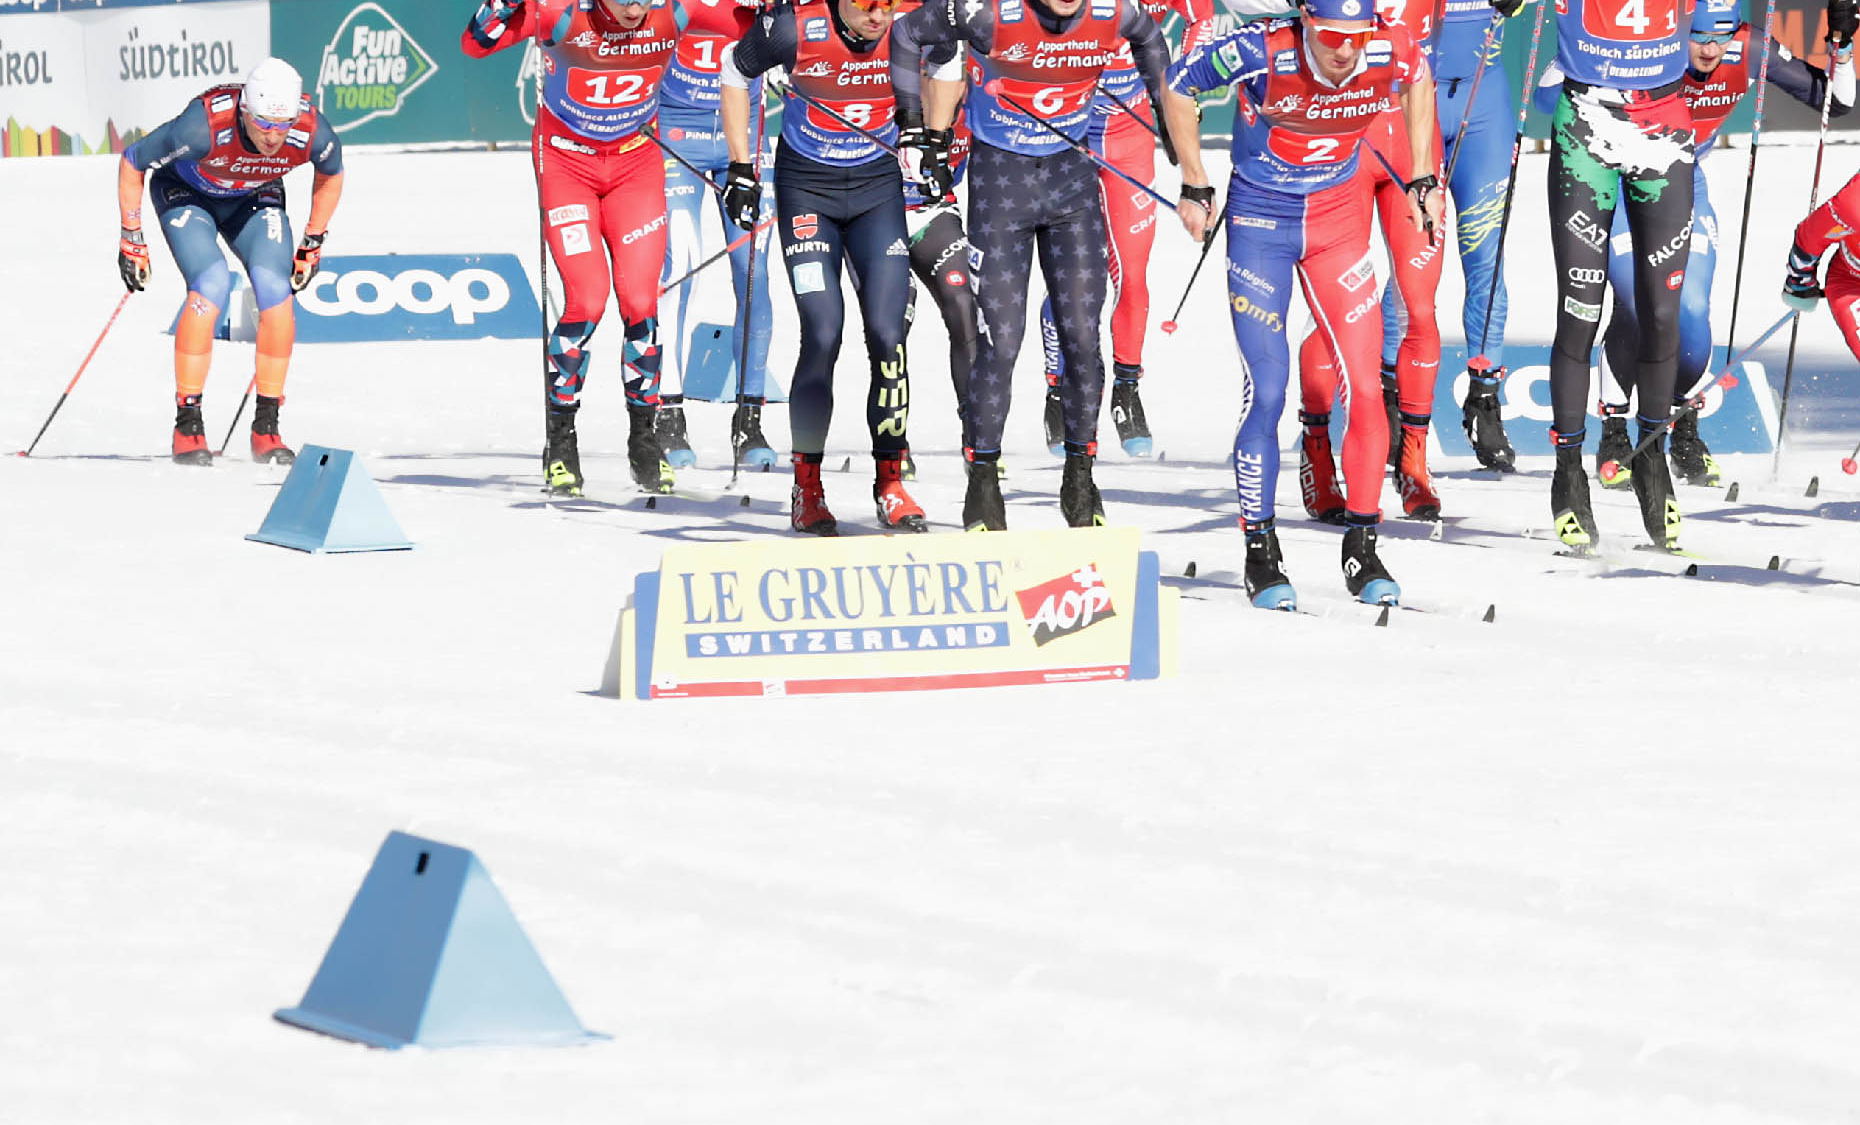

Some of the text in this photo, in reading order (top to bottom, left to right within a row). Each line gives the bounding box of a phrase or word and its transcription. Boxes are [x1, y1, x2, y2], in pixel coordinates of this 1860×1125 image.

[1665, 9, 1677, 30] 1
[353, 26, 402, 58] Fun
[598, 39, 675, 57] Germania
[1036, 39, 1098, 53] Apparthotel
[1576, 39, 1622, 59] Toblach
[323, 54, 408, 87] Active
[334, 85, 397, 109] TOURS
[585, 74, 644, 105] 12
[1031, 86, 1065, 115] 6
[1311, 86, 1374, 106] Apparthotel
[842, 103, 873, 128] 8
[1305, 97, 1390, 120] Germania
[1302, 137, 1340, 163] 2
[294, 269, 511, 325] coop
[1237, 449, 1263, 520] FRANCE
[679, 552, 1010, 625] LE GRUYÈRE
[1026, 585, 1112, 634] AOP
[699, 627, 998, 656] SWITZERLAND
